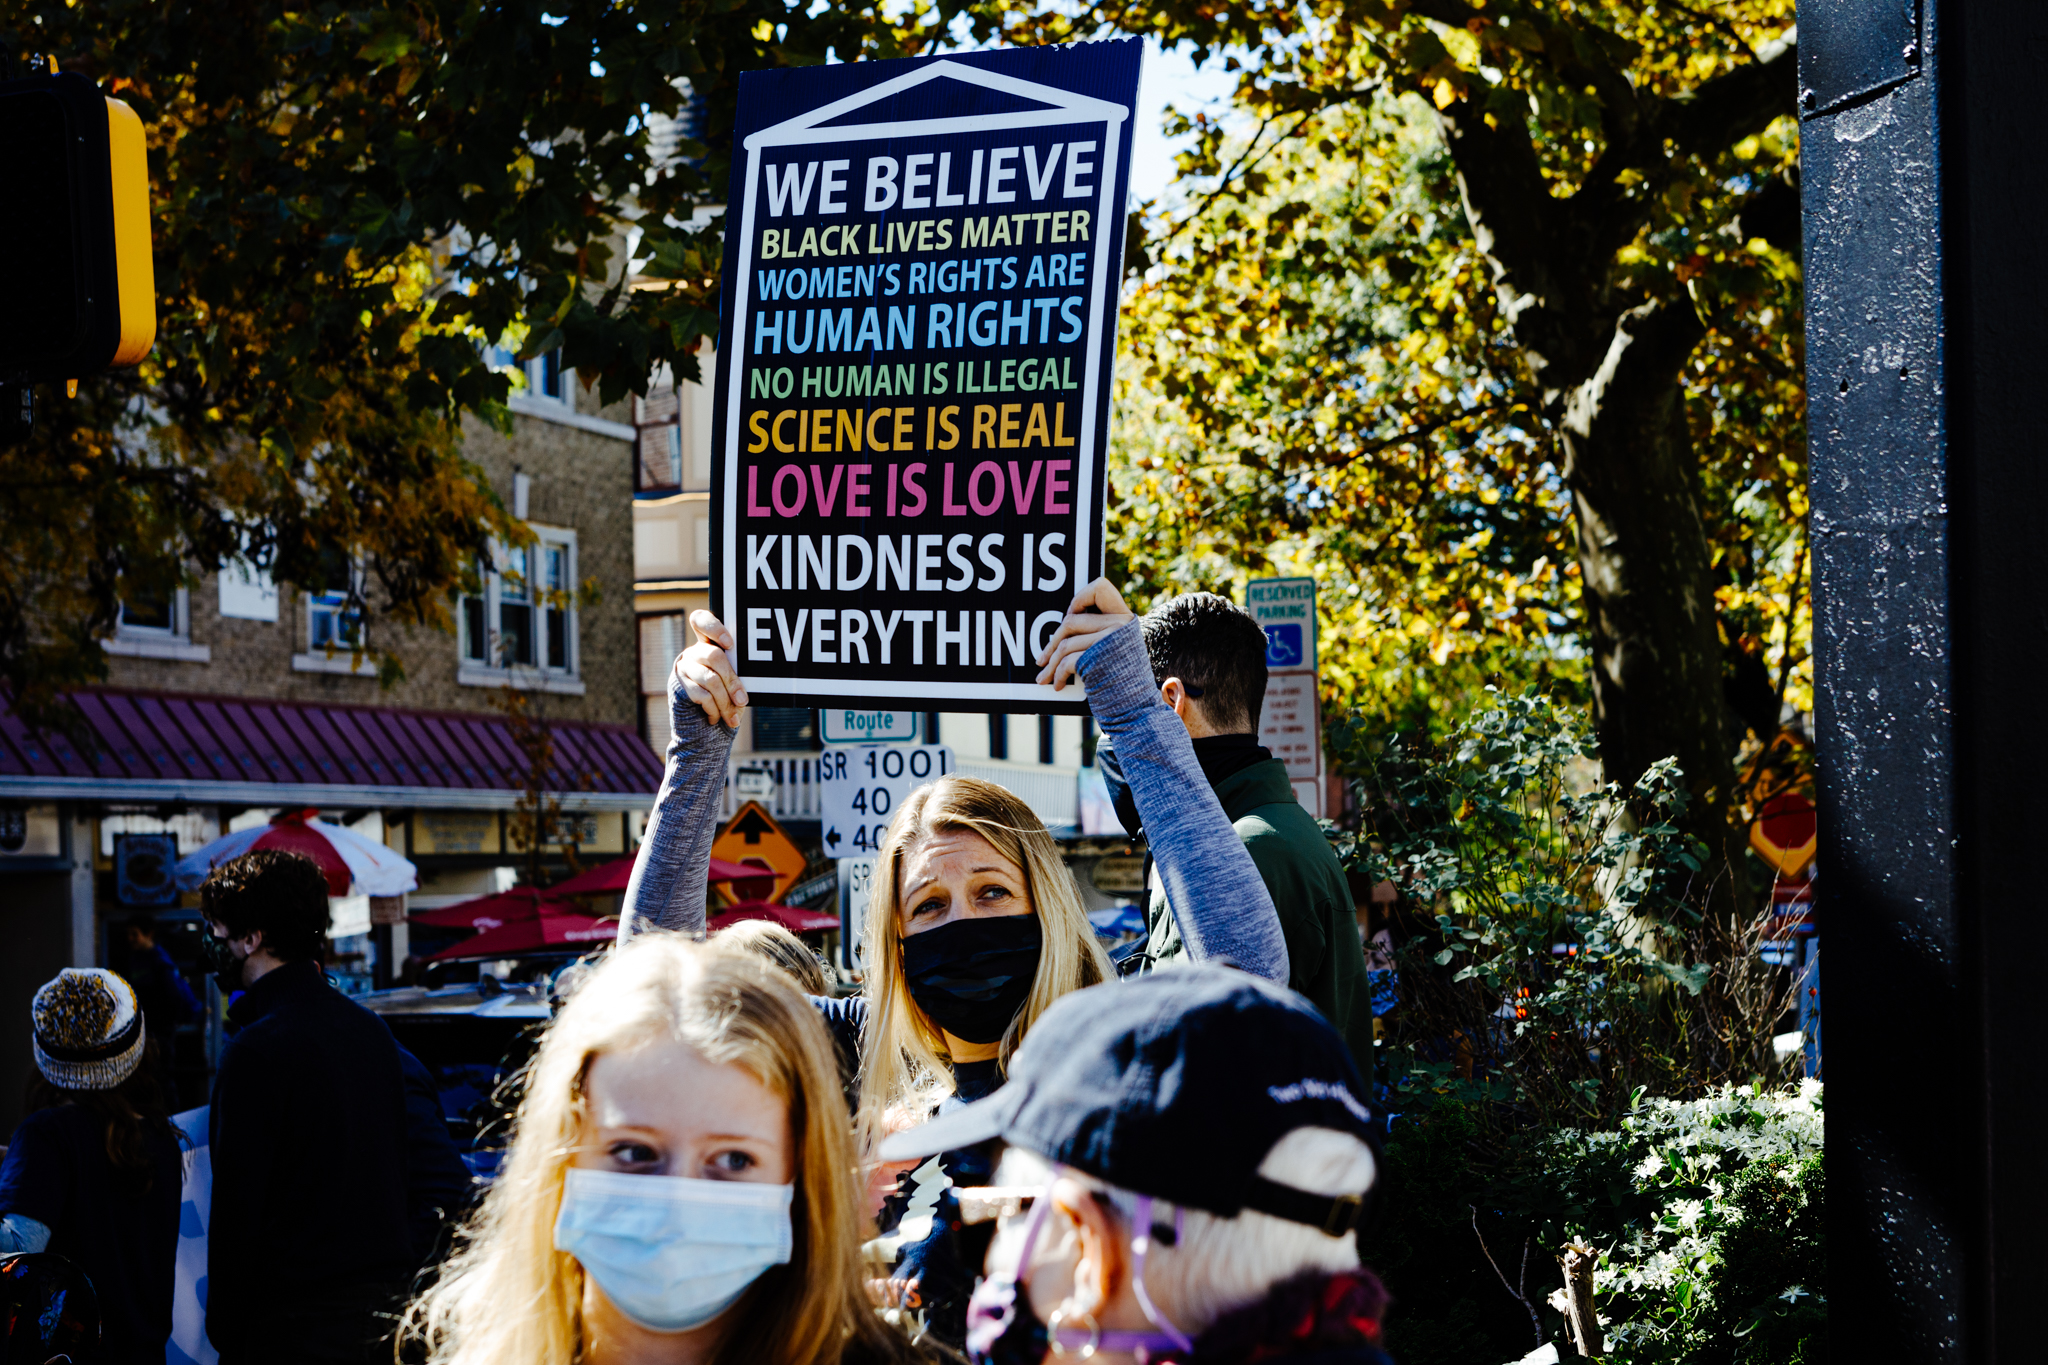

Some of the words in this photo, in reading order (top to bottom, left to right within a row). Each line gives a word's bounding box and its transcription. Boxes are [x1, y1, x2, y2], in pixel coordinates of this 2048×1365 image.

[766, 159, 850, 217] WE
[864, 140, 1096, 212] BELIEVE
[762, 225, 861, 259] BLACK
[869, 219, 953, 253] LIVES
[961, 210, 1090, 248] MATTER
[758, 263, 901, 300] WOMEN'S
[909, 256, 1018, 294] RIGHTS
[1025, 252, 1086, 288] ARE
[754, 305, 916, 354] HUMAN
[927, 296, 1083, 348] RIGHTS
[751, 367, 793, 398] NO
[802, 364, 915, 397] HUMAN
[924, 362, 948, 394] IS
[957, 357, 1077, 393] ILLEGAL
[748, 407, 914, 453] SCIENCE
[926, 406, 960, 451] IS
[972, 402, 1074, 448] REAL
[748, 464, 871, 517] LOVE
[887, 463, 927, 517] IS
[943, 460, 1071, 516] LOVE
[747, 533, 1005, 591] KINDNESS
[1022, 532, 1066, 592] IS
[747, 608, 1063, 667] EVERYTHING
[844, 711, 893, 730] Route
[823, 752, 847, 780] SR
[868, 750, 946, 778] 1001
[852, 787, 890, 815] 40
